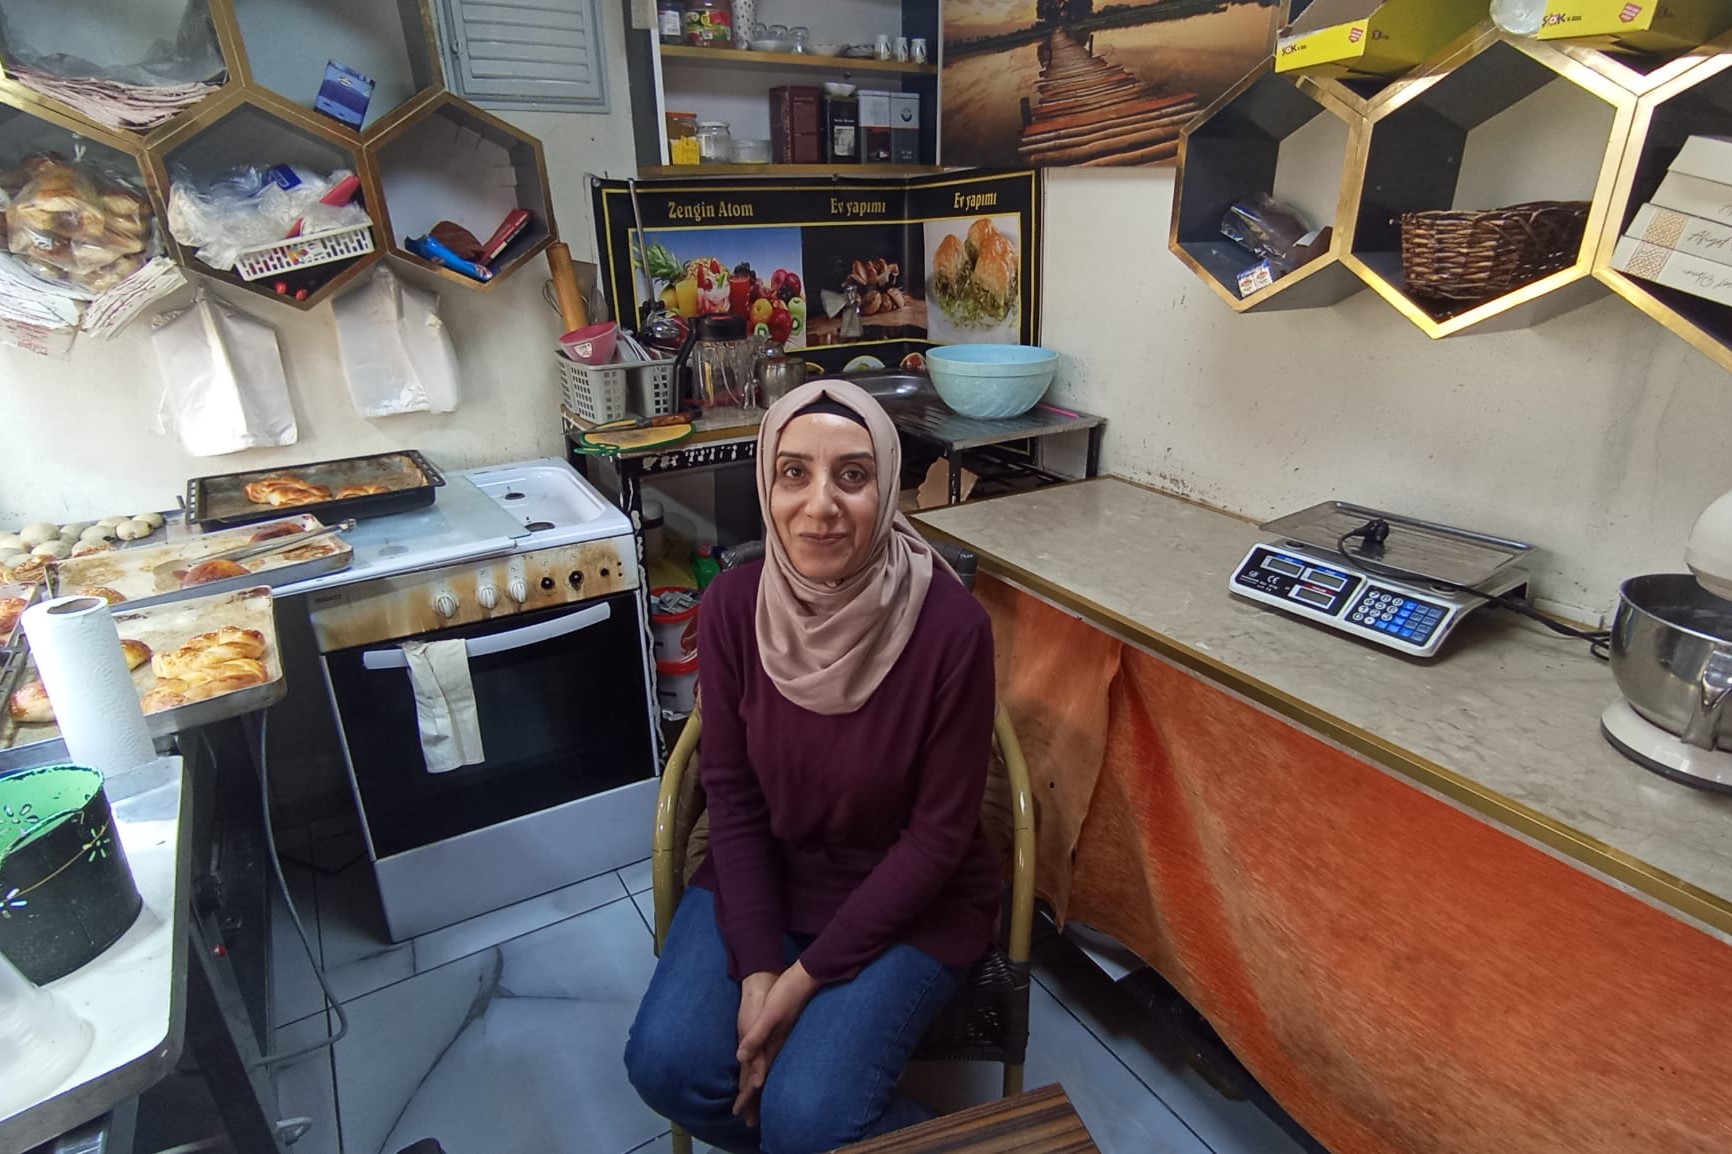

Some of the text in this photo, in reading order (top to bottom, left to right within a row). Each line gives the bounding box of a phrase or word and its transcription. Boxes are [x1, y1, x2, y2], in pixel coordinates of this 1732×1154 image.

[830, 198, 886, 217] Ev yapımı
[953, 192, 997, 211] Ev yapımı
[668, 201, 754, 222] Zengin Atom
